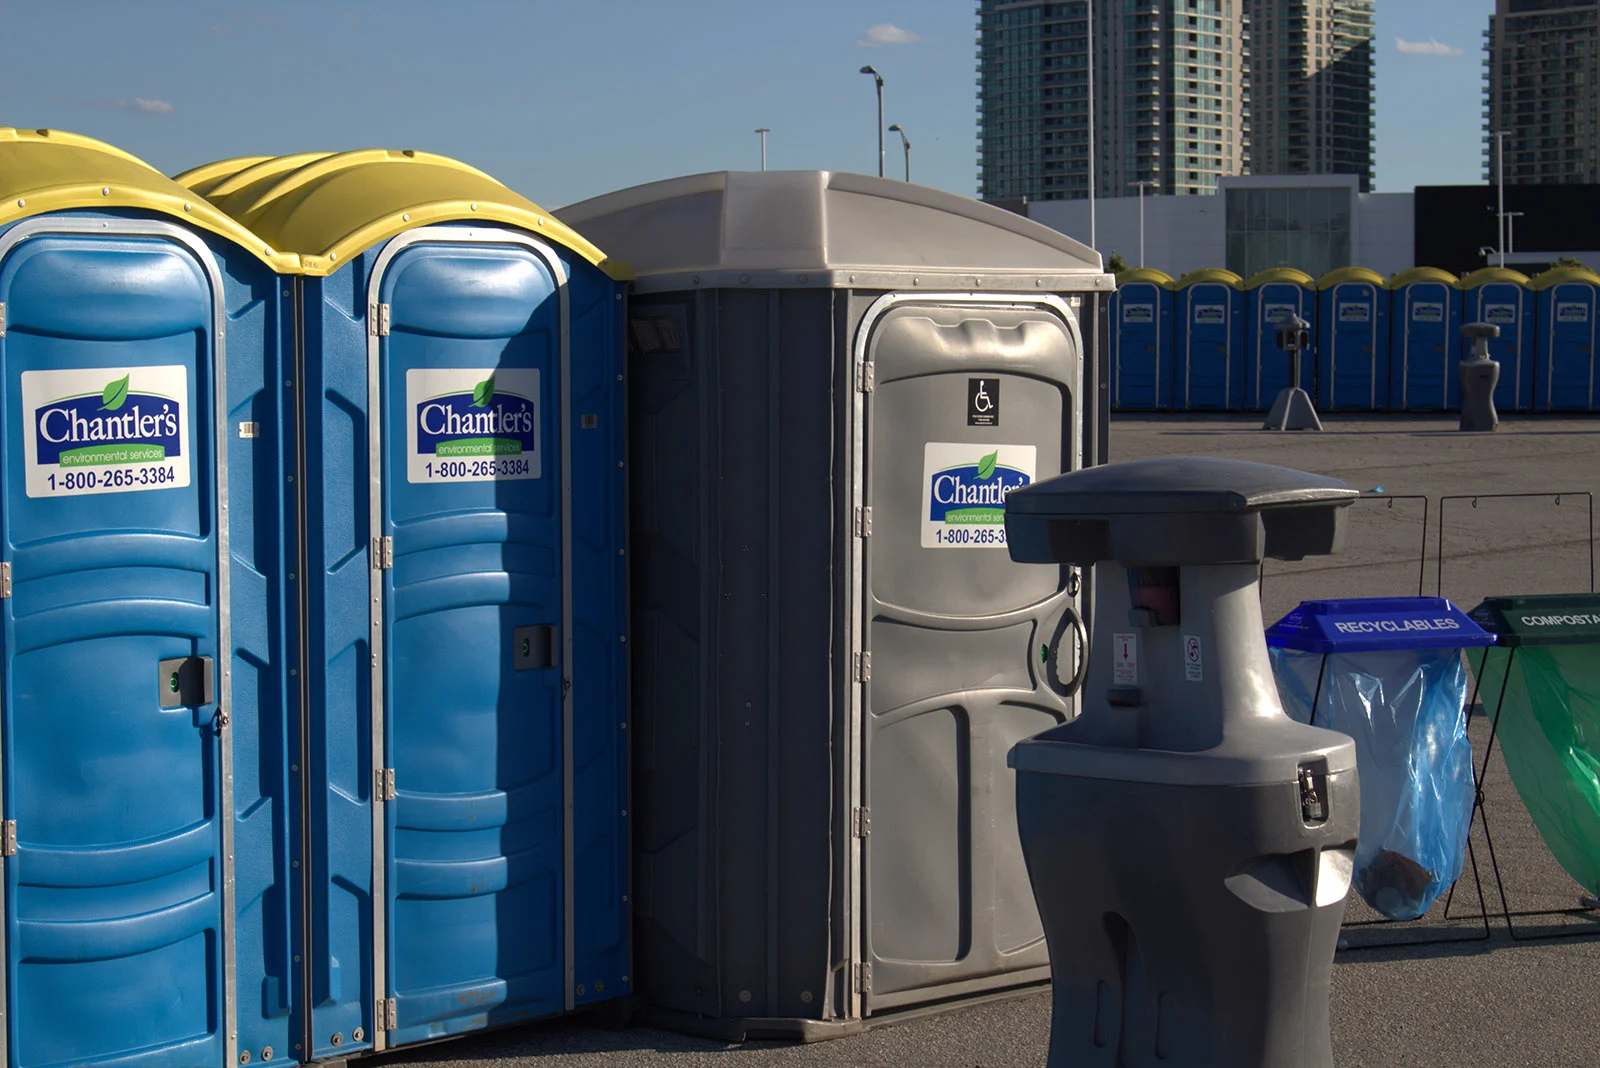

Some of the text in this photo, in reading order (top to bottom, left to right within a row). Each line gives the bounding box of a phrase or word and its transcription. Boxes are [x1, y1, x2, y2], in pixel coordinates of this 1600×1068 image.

[39, 404, 177, 443] Chantler's
[420, 403, 532, 435] Chantler's
[62, 449, 163, 464] environmental services
[439, 444, 492, 454] environmental
[425, 459, 529, 478] 1-800-265-3384
[47, 466, 175, 491] 1-800-265-3384
[936, 529, 1007, 544] 1-800-265-3
[1334, 618, 1460, 634] RECYCLABLES
[1521, 614, 1600, 626] COMPOSTA
